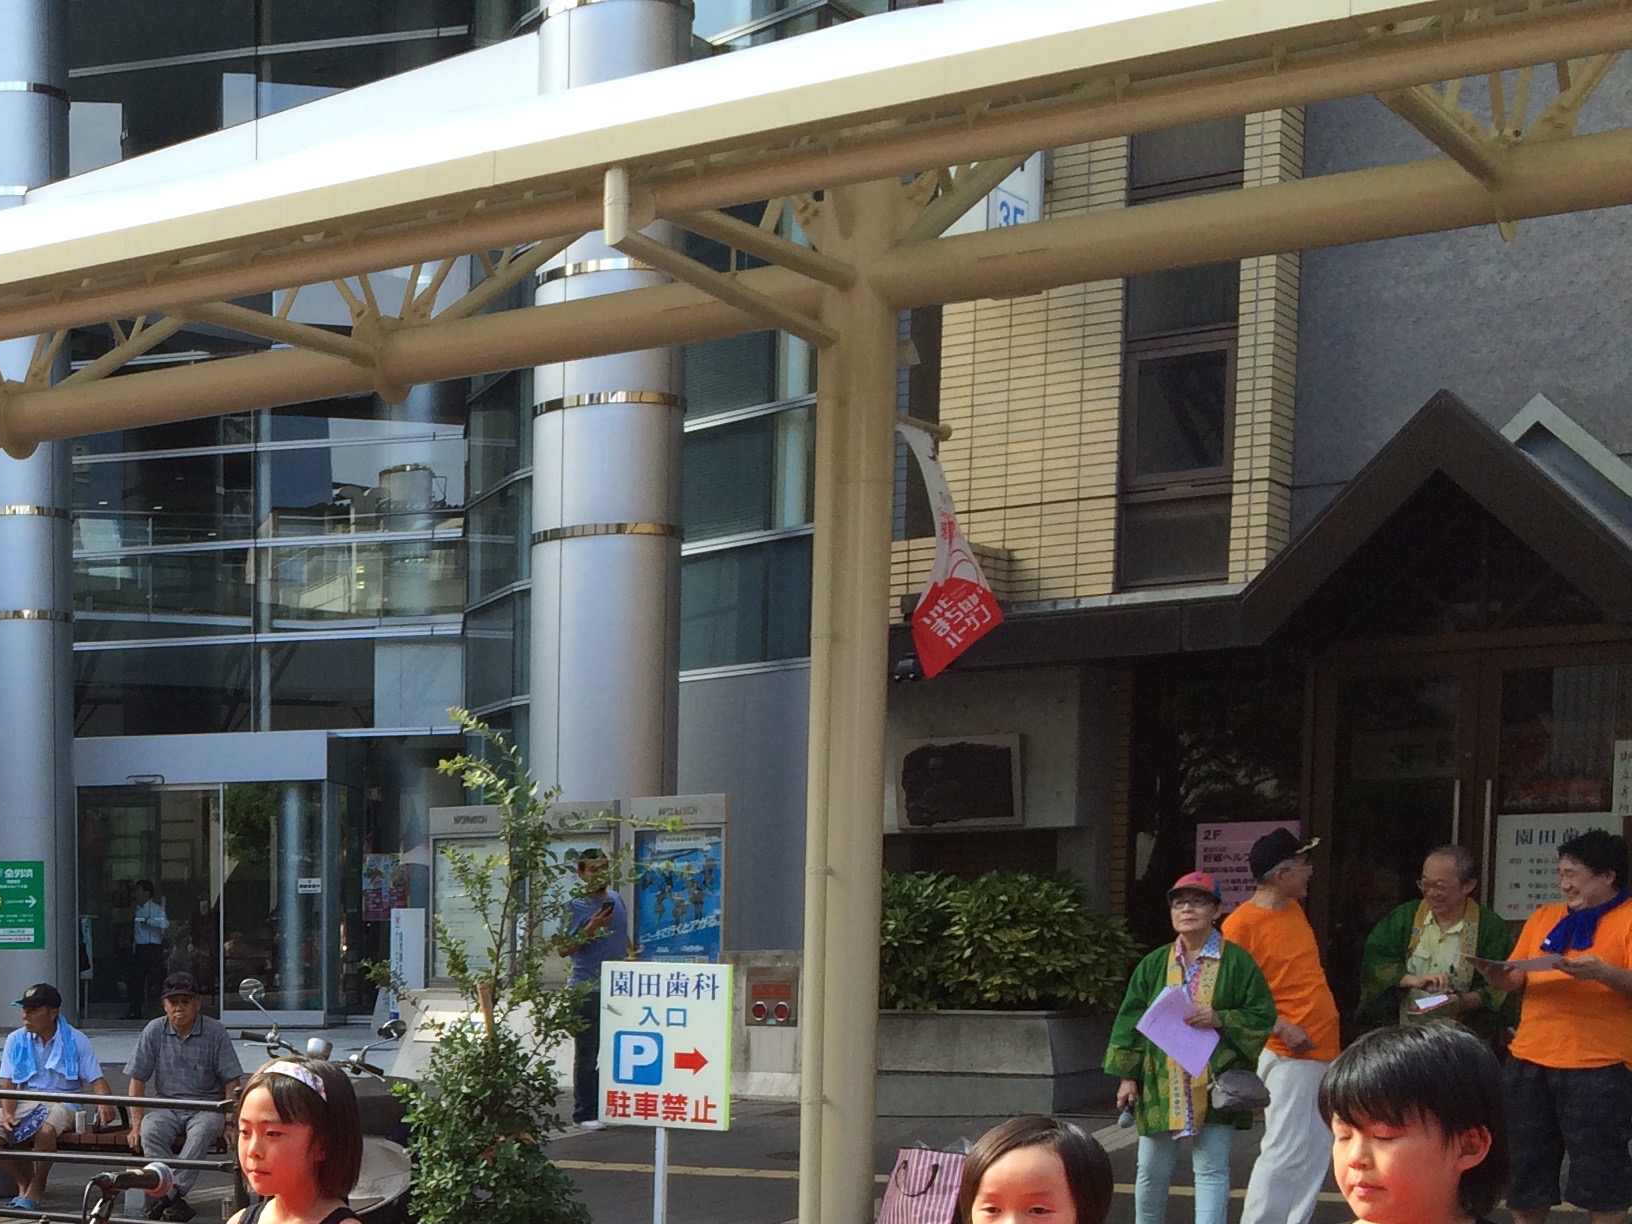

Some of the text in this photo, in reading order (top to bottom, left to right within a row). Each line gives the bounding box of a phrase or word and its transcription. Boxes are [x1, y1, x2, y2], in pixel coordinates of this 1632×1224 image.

[1203, 829, 1222, 840] 2F
[610, 970, 720, 1001] 園田歯科
[638, 1006, 688, 1028] 入口
[619, 1034, 658, 1080] P
[604, 1091, 718, 1125] 駐車禁止
